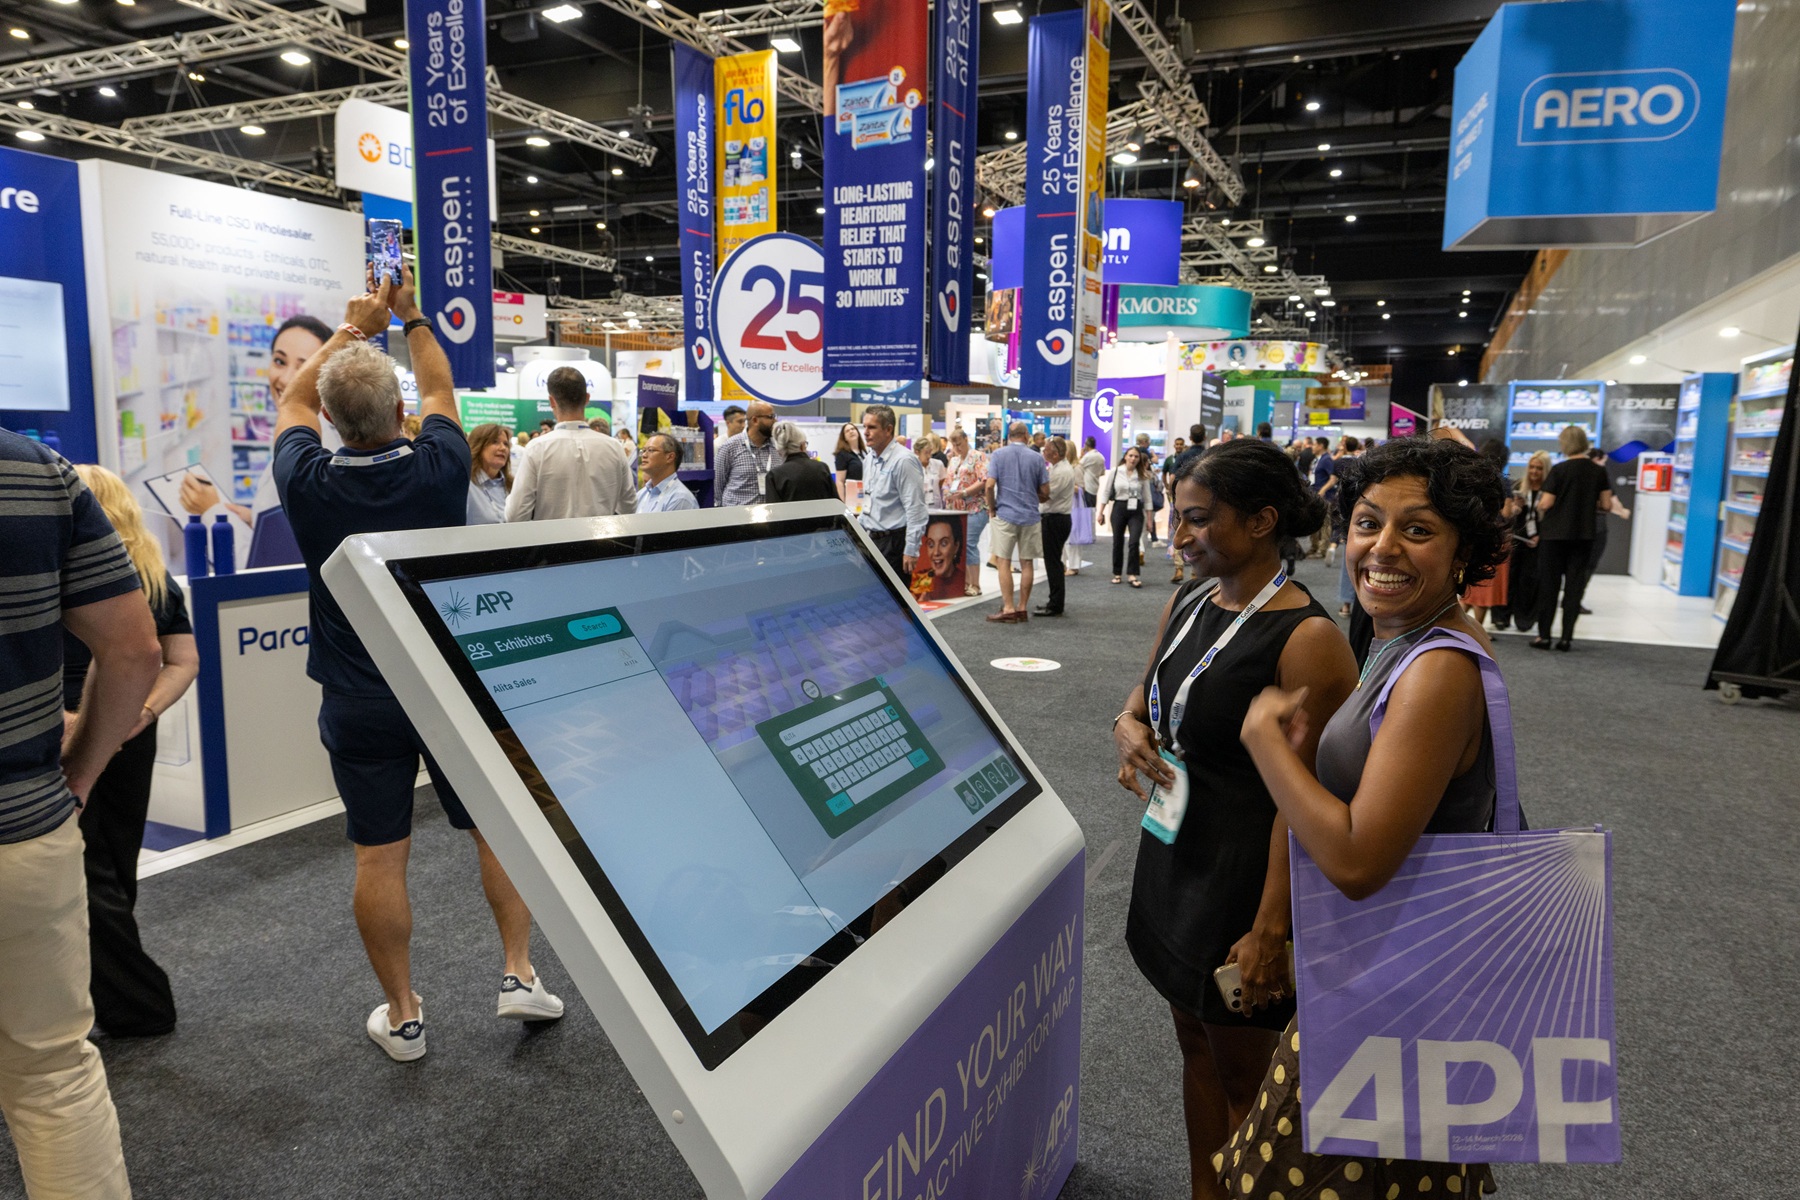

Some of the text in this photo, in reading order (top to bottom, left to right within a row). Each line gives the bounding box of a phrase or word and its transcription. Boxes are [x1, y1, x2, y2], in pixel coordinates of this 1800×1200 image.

[426, 11, 447, 127] 25 Years
[946, 36, 957, 79] 25
[958, 52, 969, 86] of
[448, 98, 468, 124] of
[723, 88, 764, 126] flo
[1533, 84, 1685, 129] AERO
[1063, 56, 1084, 194] of Excellence
[697, 93, 709, 217] of Excellence
[1042, 104, 1062, 195] 25 Years
[687, 131, 698, 214] 25 Years
[833, 181, 913, 205] LONG-LASTING
[947, 140, 962, 269] aspen
[841, 203, 906, 225] HEARTBURN
[442, 176, 467, 287] aspen
[840, 224, 906, 246] RELIEF THAT
[135, 250, 178, 265] natural
[182, 255, 218, 271] health
[222, 261, 242, 275] and
[245, 266, 281, 282] private
[282, 269, 306, 285] label
[205, 241, 254, 260] products
[843, 246, 903, 267] STARTS TO
[694, 250, 707, 330] aspen
[849, 268, 897, 287] WORK IN
[1048, 233, 1071, 321] aspen
[740, 264, 824, 354] 25
[836, 290, 853, 308] 30
[740, 359, 767, 371] Years
[770, 362, 779, 371] of
[1609, 398, 1676, 410] FLEXIBLE
[1439, 418, 1490, 429] POWER
[475, 591, 514, 616] APP
[1240, 604, 1256, 618] Guild
[238, 626, 309, 655] Para
[494, 633, 554, 653] Exhibitors
[581, 621, 608, 632] Search
[493, 677, 537, 694] Alita Sales
[957, 981, 1027, 1110] YOUR
[1034, 914, 1077, 1008] WAY
[987, 1012, 1049, 1126] EXHIBITOR
[1052, 976, 1075, 1028] MAP
[1042, 1084, 1074, 1169] APP
